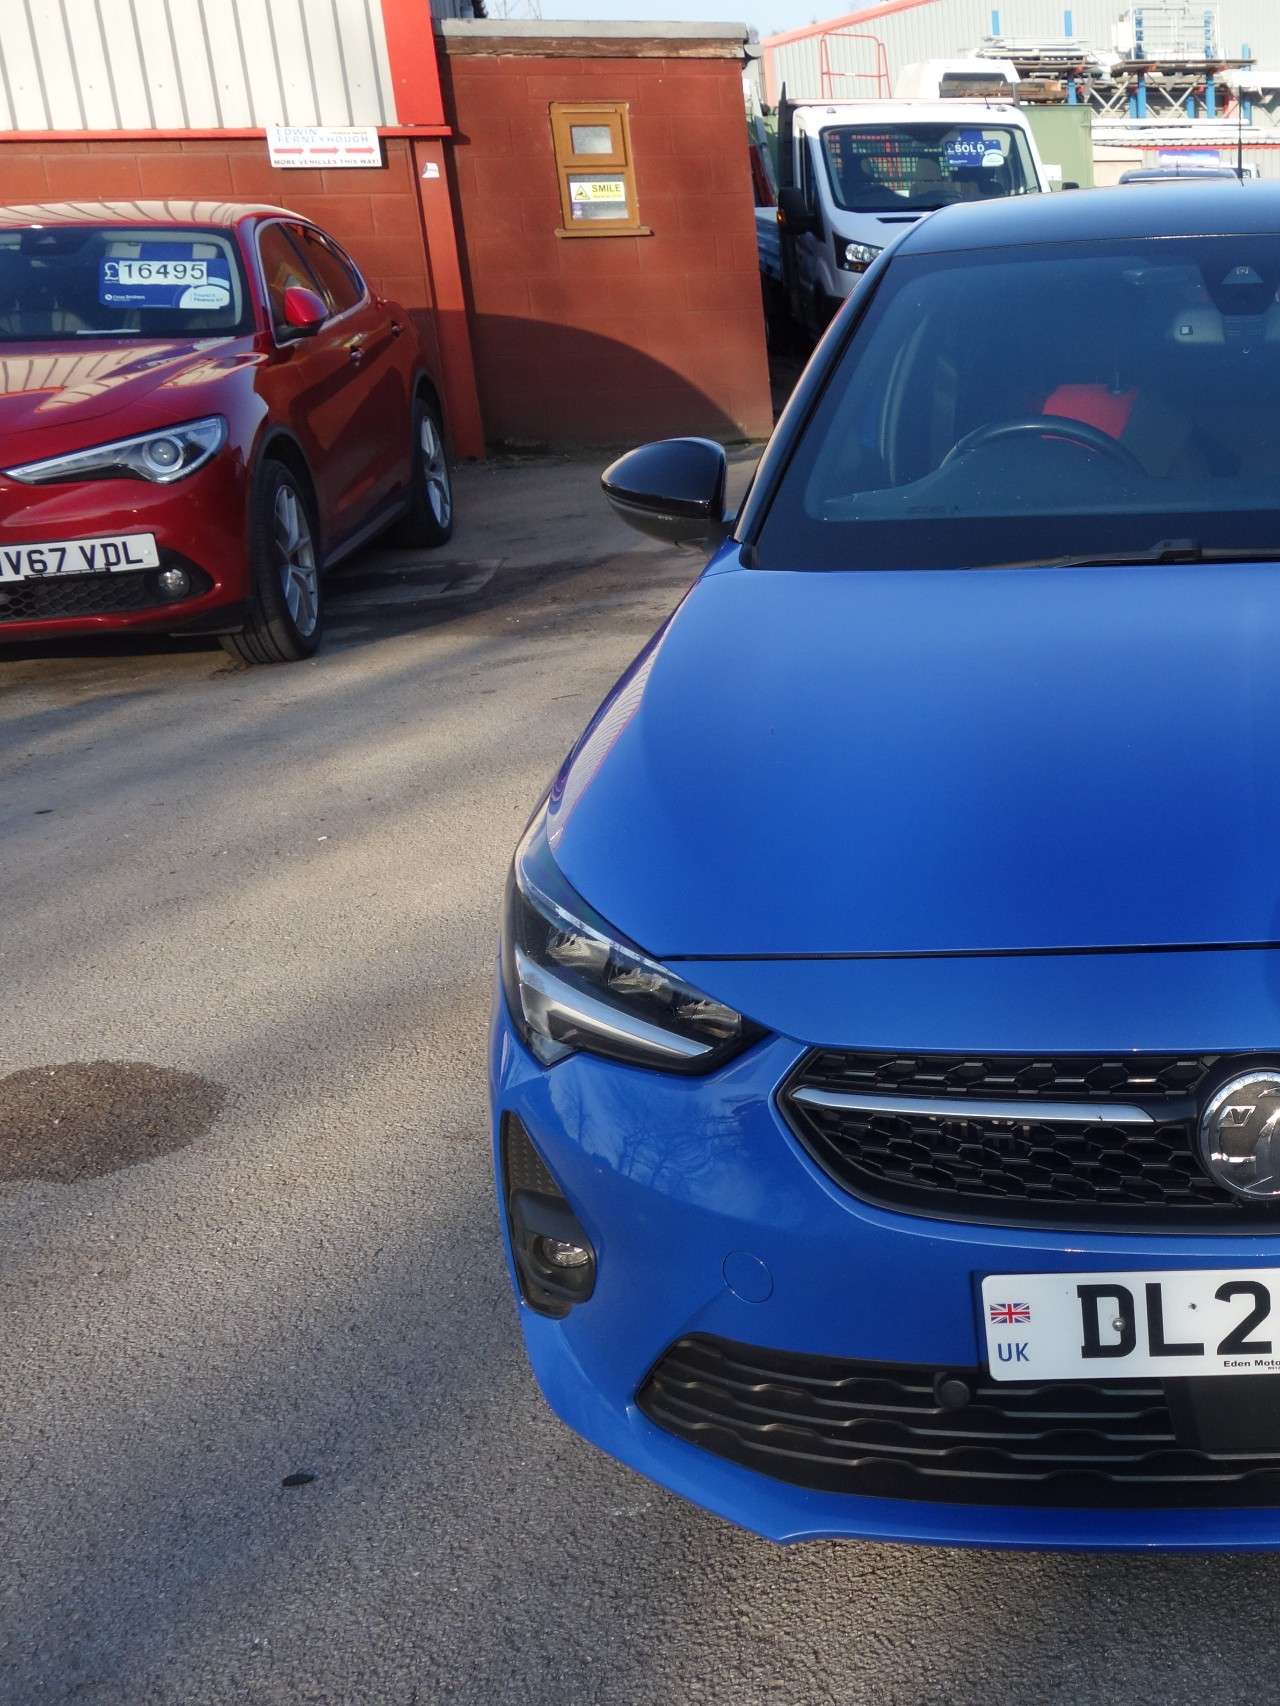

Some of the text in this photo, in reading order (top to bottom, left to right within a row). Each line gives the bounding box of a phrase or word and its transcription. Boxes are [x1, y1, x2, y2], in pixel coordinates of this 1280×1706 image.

[276, 128, 318, 136] EDWIN
[954, 144, 985, 153] SOLD
[591, 184, 621, 193] SMILE
[0, 541, 144, 577] V67 VDL
[997, 1342, 1030, 1362] UK
[1223, 1360, 1251, 1368] Eden
